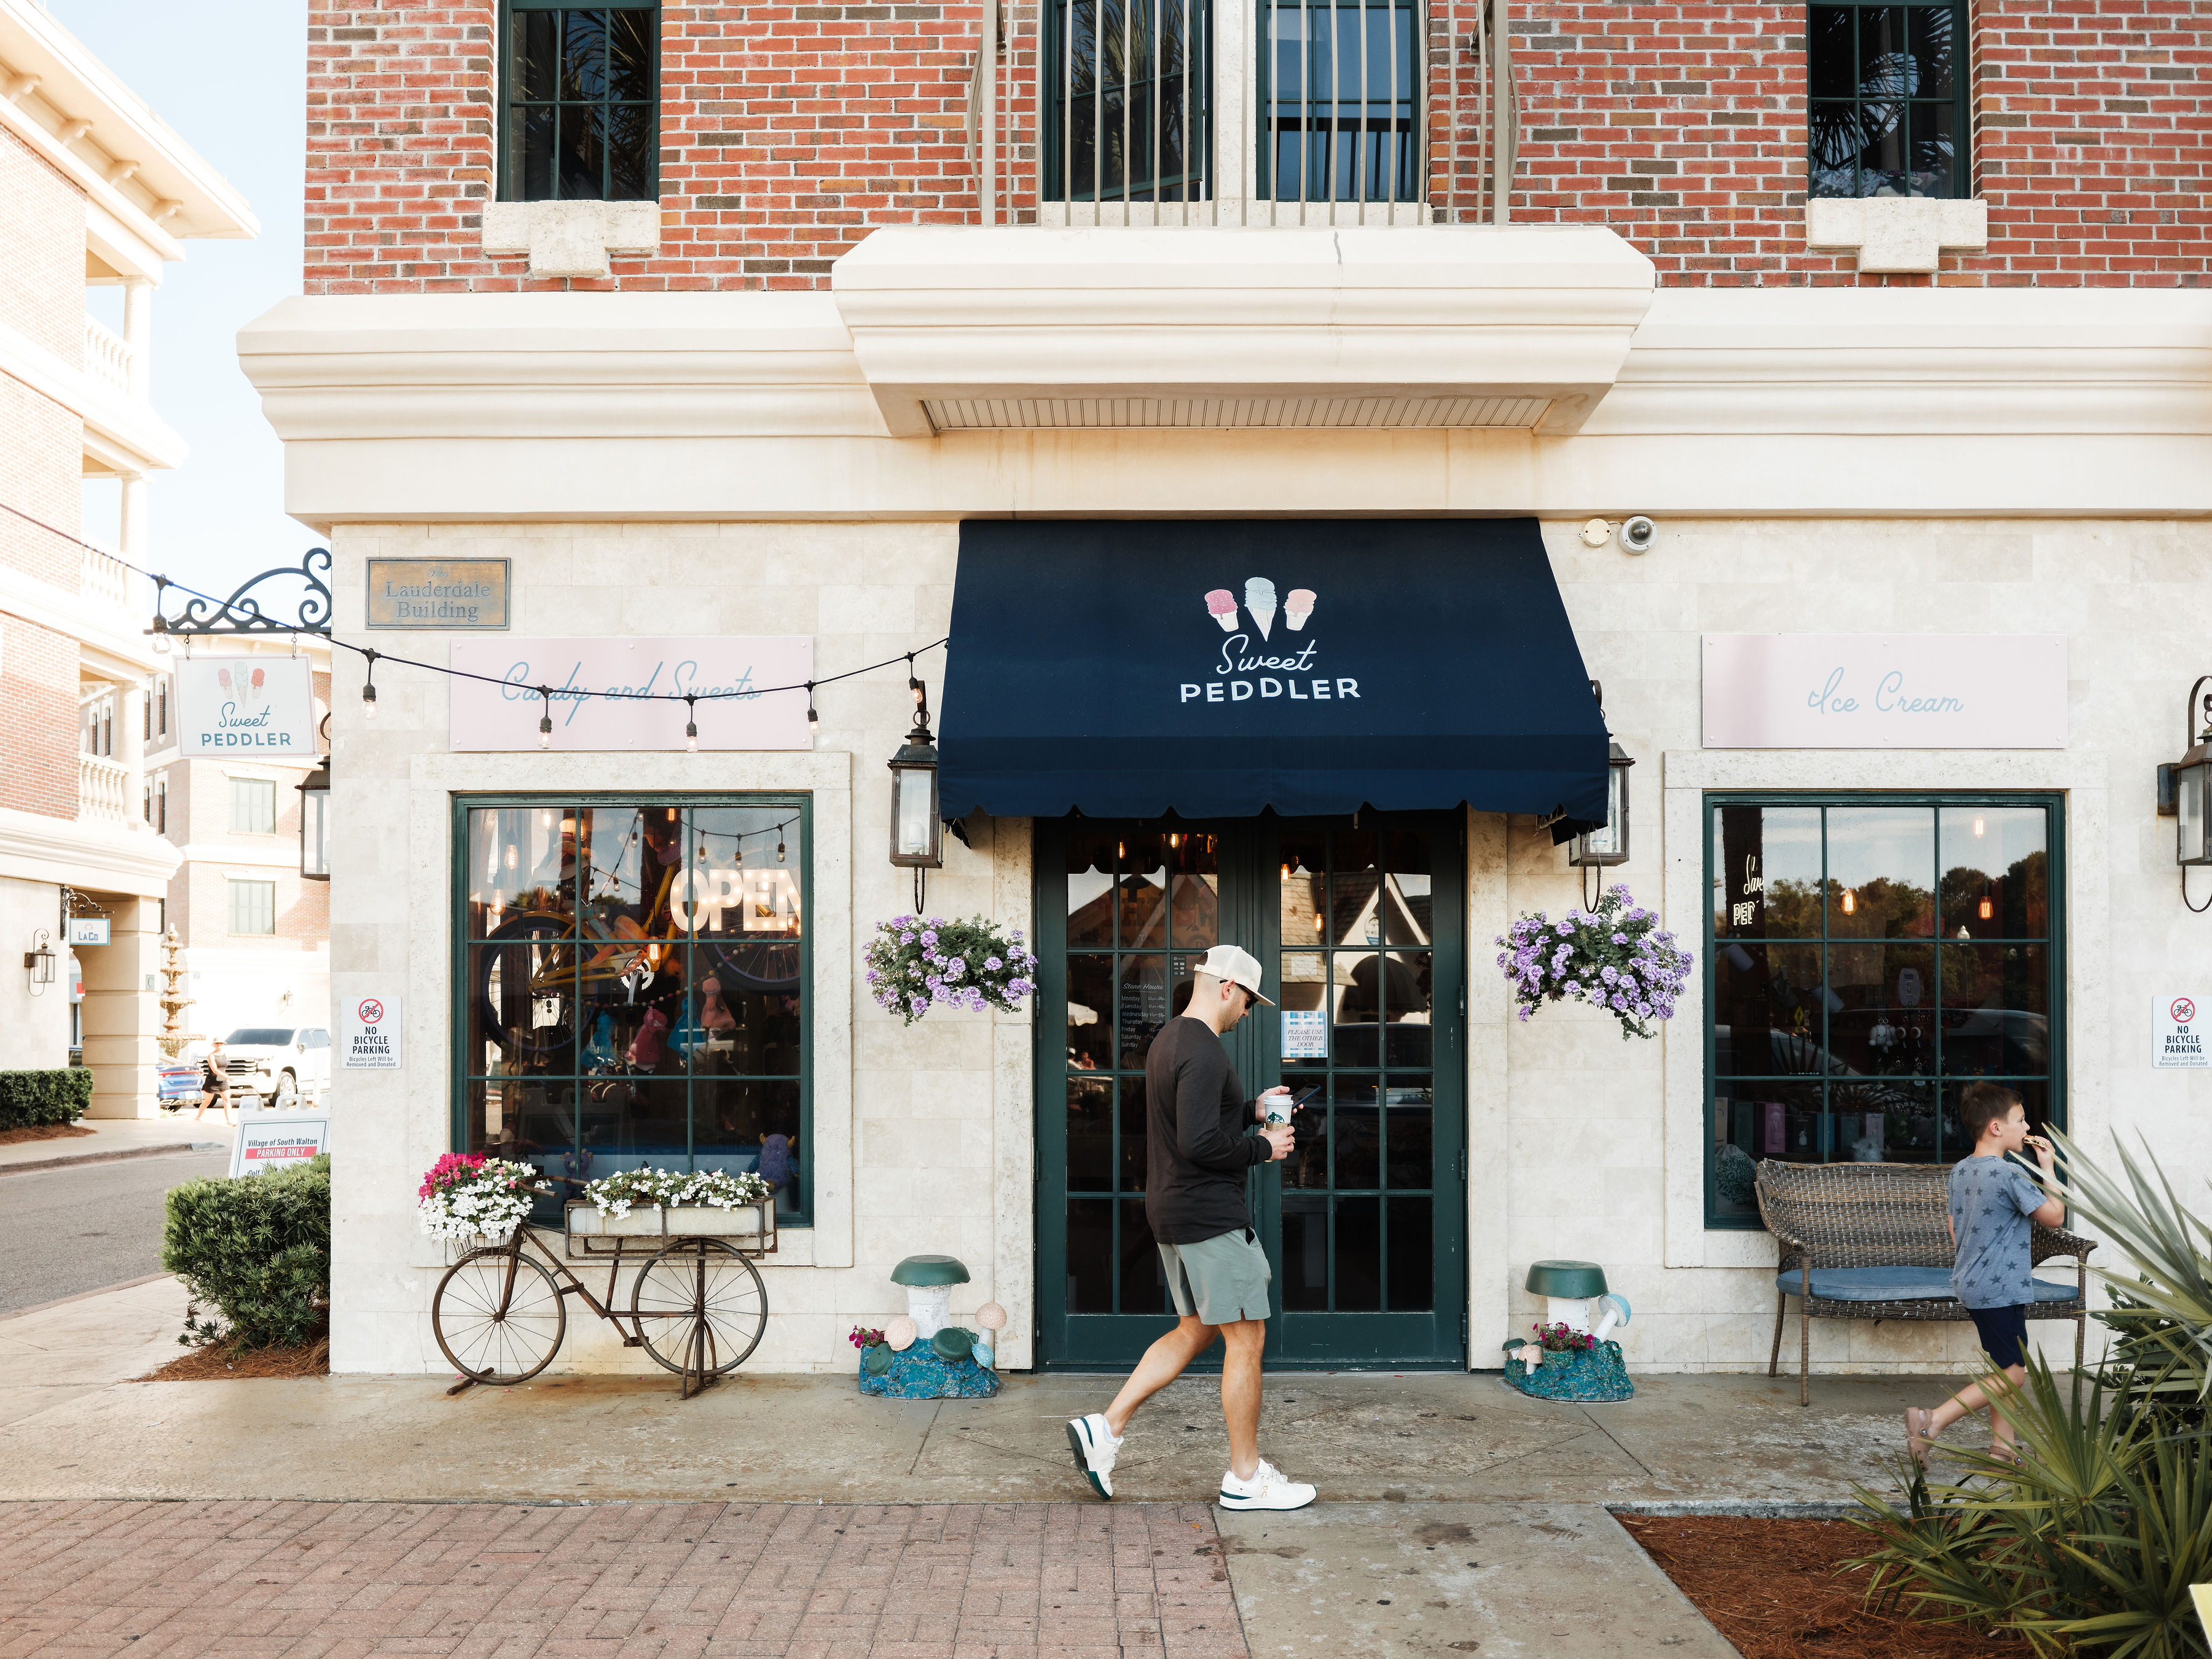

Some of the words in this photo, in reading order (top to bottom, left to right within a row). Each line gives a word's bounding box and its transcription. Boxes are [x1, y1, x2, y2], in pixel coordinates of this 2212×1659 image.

[428, 566, 449, 578] The
[385, 581, 490, 598] Lauderdale
[396, 601, 479, 622] Building
[1216, 633, 1317, 674] Sweet
[501, 661, 591, 726] Candy
[604, 661, 664, 701] and
[669, 660, 763, 702] Sweets
[1180, 677, 1361, 702] PEDDLER
[1808, 666, 1859, 715] Ice
[1875, 670, 1965, 713] Cream
[219, 702, 270, 728] Sweet
[202, 733, 291, 747] PEDDLER
[670, 868, 801, 931] OPEN
[354, 1036, 388, 1045] BICYCLE
[256, 1149, 285, 1158] PARKING
[287, 1148, 305, 1156] ONLY
